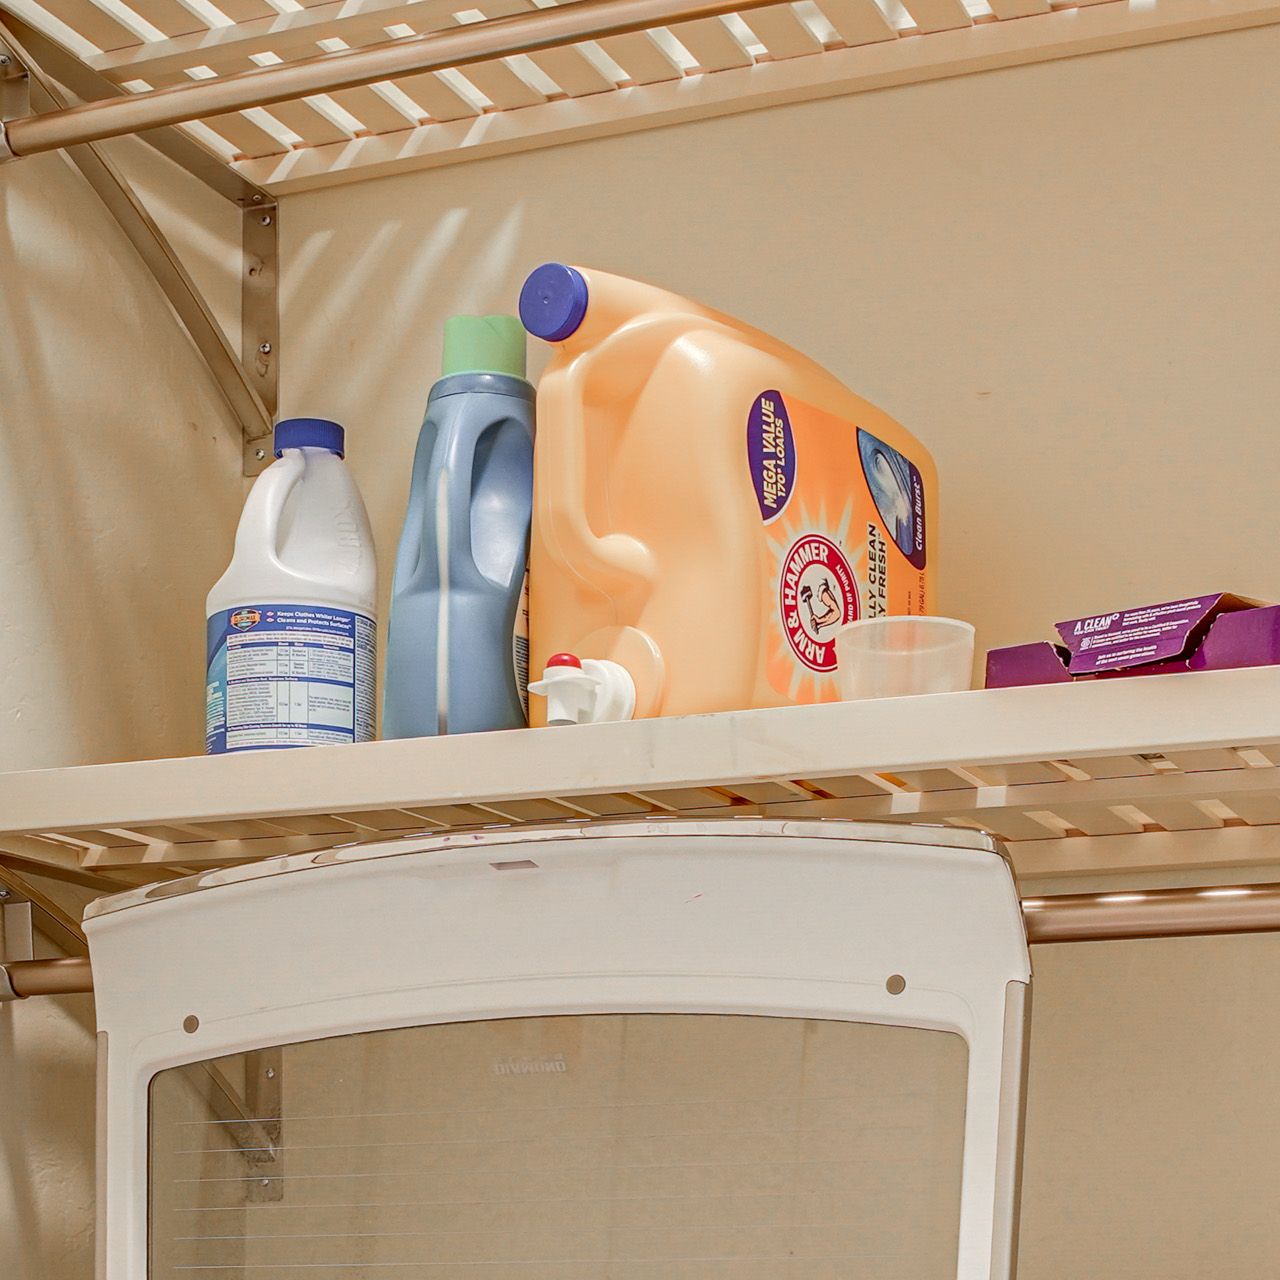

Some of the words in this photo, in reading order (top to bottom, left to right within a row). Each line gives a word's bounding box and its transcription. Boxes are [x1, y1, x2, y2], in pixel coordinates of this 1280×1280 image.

[760, 398, 776, 455] VALUE
[774, 418, 785, 466] LOADS
[762, 459, 778, 509] MEGA
[915, 515, 923, 551] Clean
[868, 524, 877, 585] CLEAN
[784, 542, 829, 606] HAMMER
[836, 564, 851, 592] PURITY
[846, 593, 854, 603] OF
[787, 611, 800, 628] &
[1074, 620, 1083, 632] A
[1084, 614, 1113, 631] CLEAN
[793, 631, 826, 664] ARM
